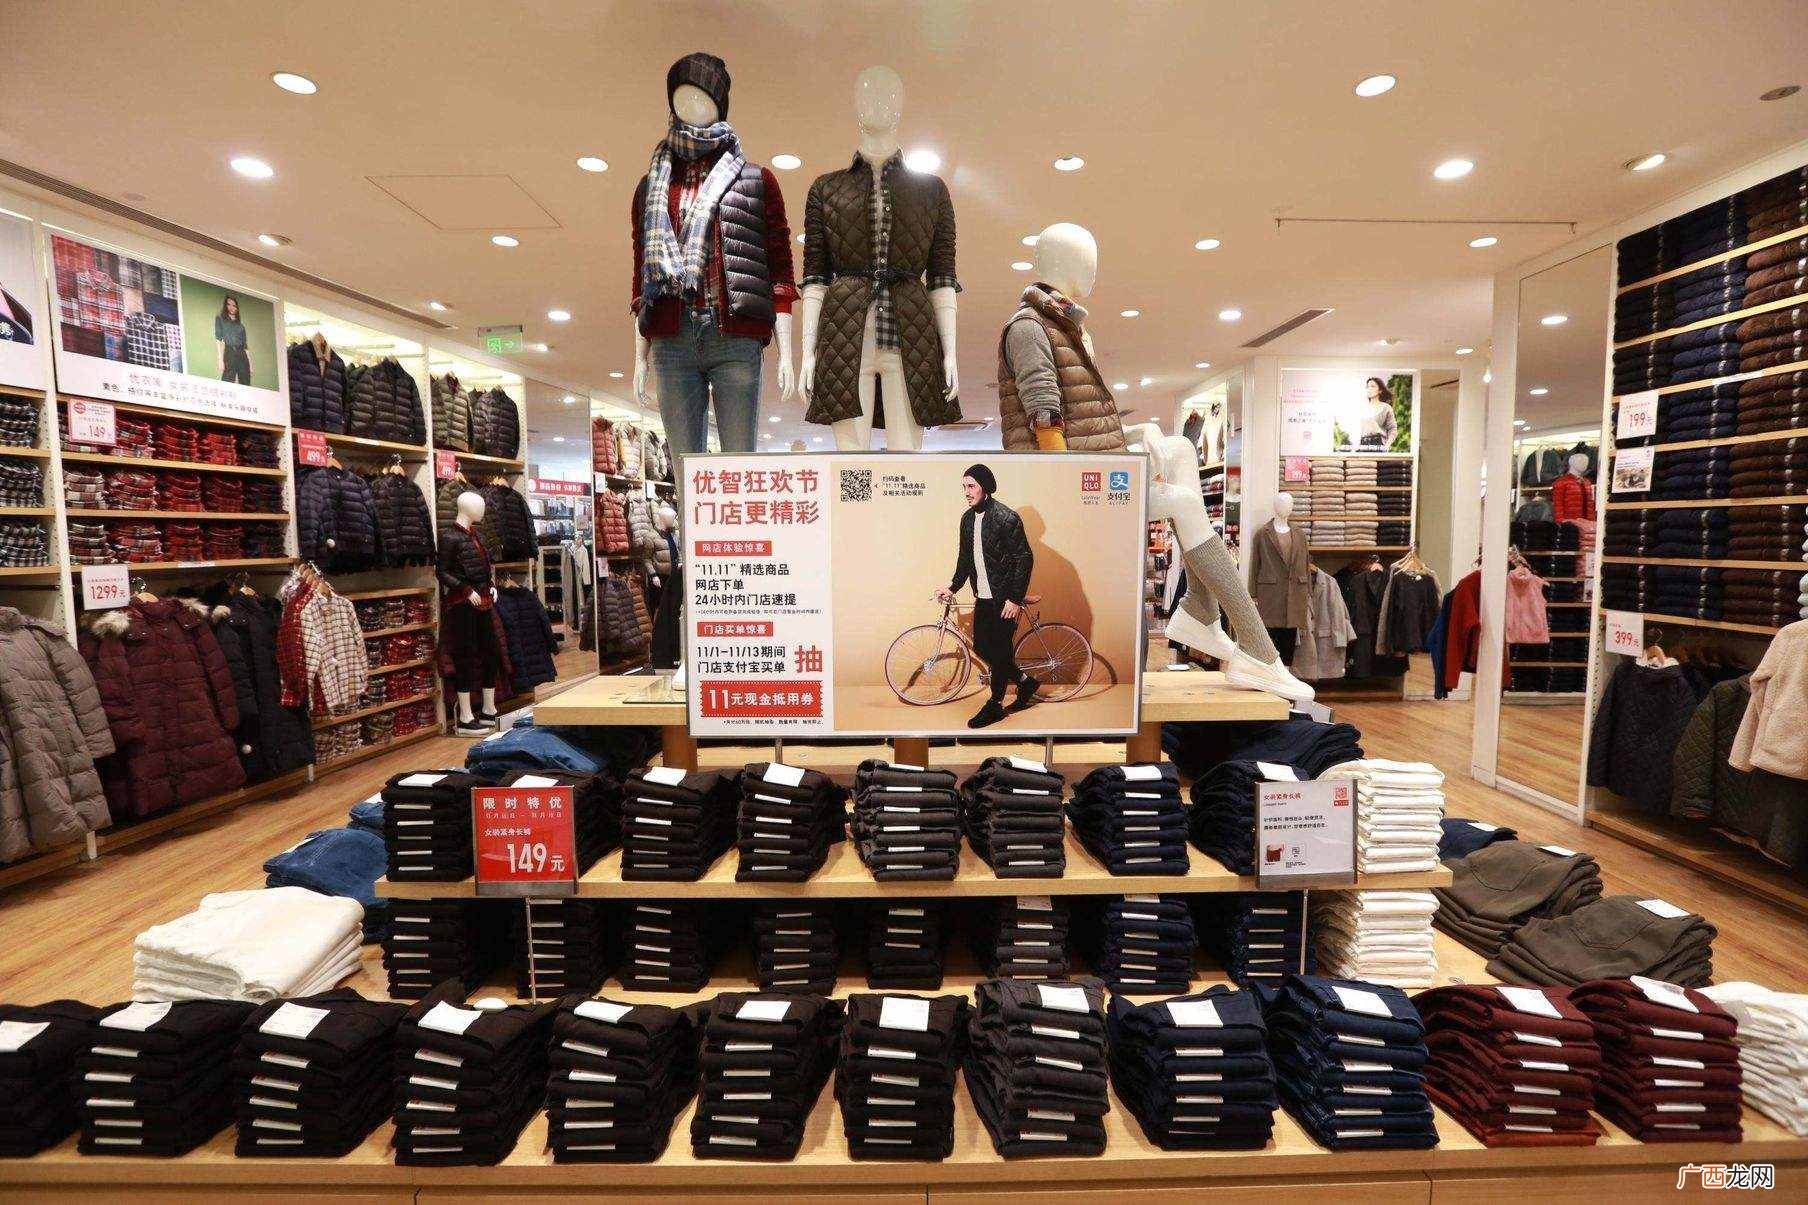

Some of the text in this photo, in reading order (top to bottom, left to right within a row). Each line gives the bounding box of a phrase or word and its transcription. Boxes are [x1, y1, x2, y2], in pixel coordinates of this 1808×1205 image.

[692, 469, 819, 495] 优智狂欢节
[694, 500, 820, 525] 门店更精彩
[702, 542, 765, 553] 网店体验惊喜
[695, 579, 744, 591] 网店下单
[695, 593, 797, 606] 24小时内门店速提
[703, 624, 767, 635] 门店买单惊喜
[794, 645, 823, 673] 抽
[697, 661, 786, 674] 门店支付宝买单
